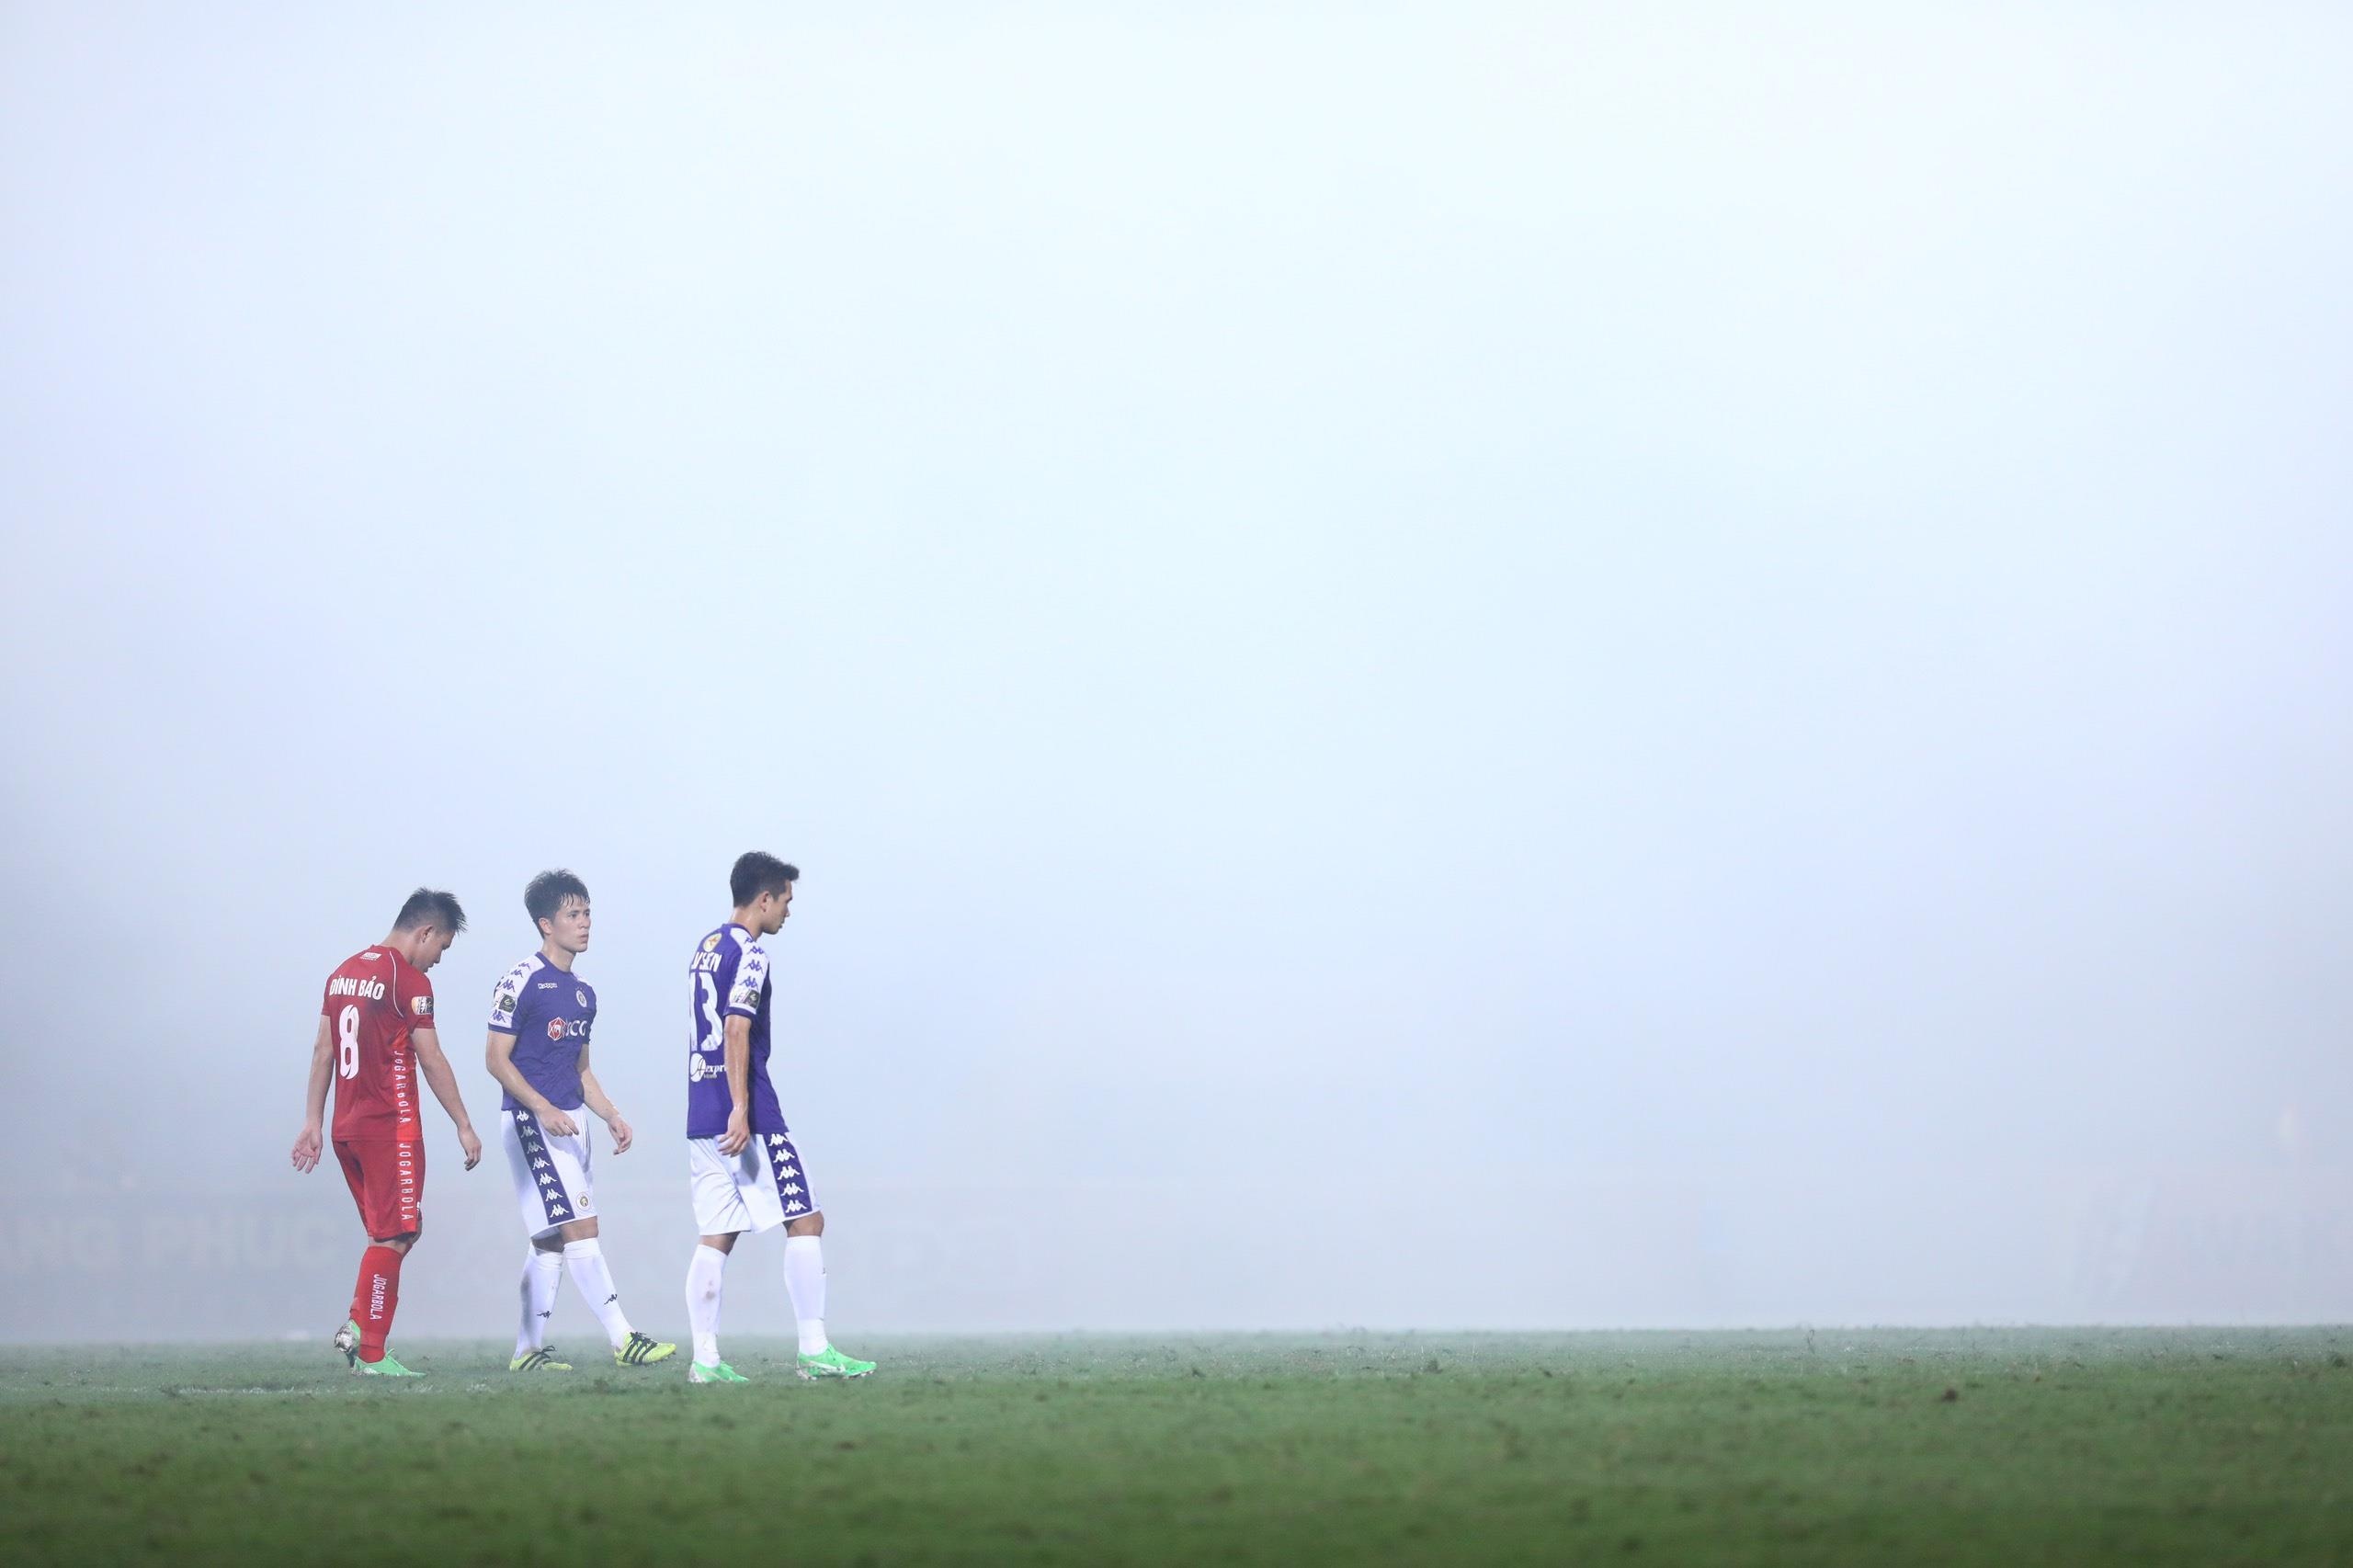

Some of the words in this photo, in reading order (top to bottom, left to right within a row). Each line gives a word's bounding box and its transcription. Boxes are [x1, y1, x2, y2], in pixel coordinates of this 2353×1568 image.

[358, 975, 385, 1000] BẢO
[339, 1004, 359, 1080] 8
[393, 1051, 412, 1123] JOGARBOLA
[399, 1142, 414, 1221] JOGARBOLA
[369, 1273, 387, 1320] JOGARBOLA
